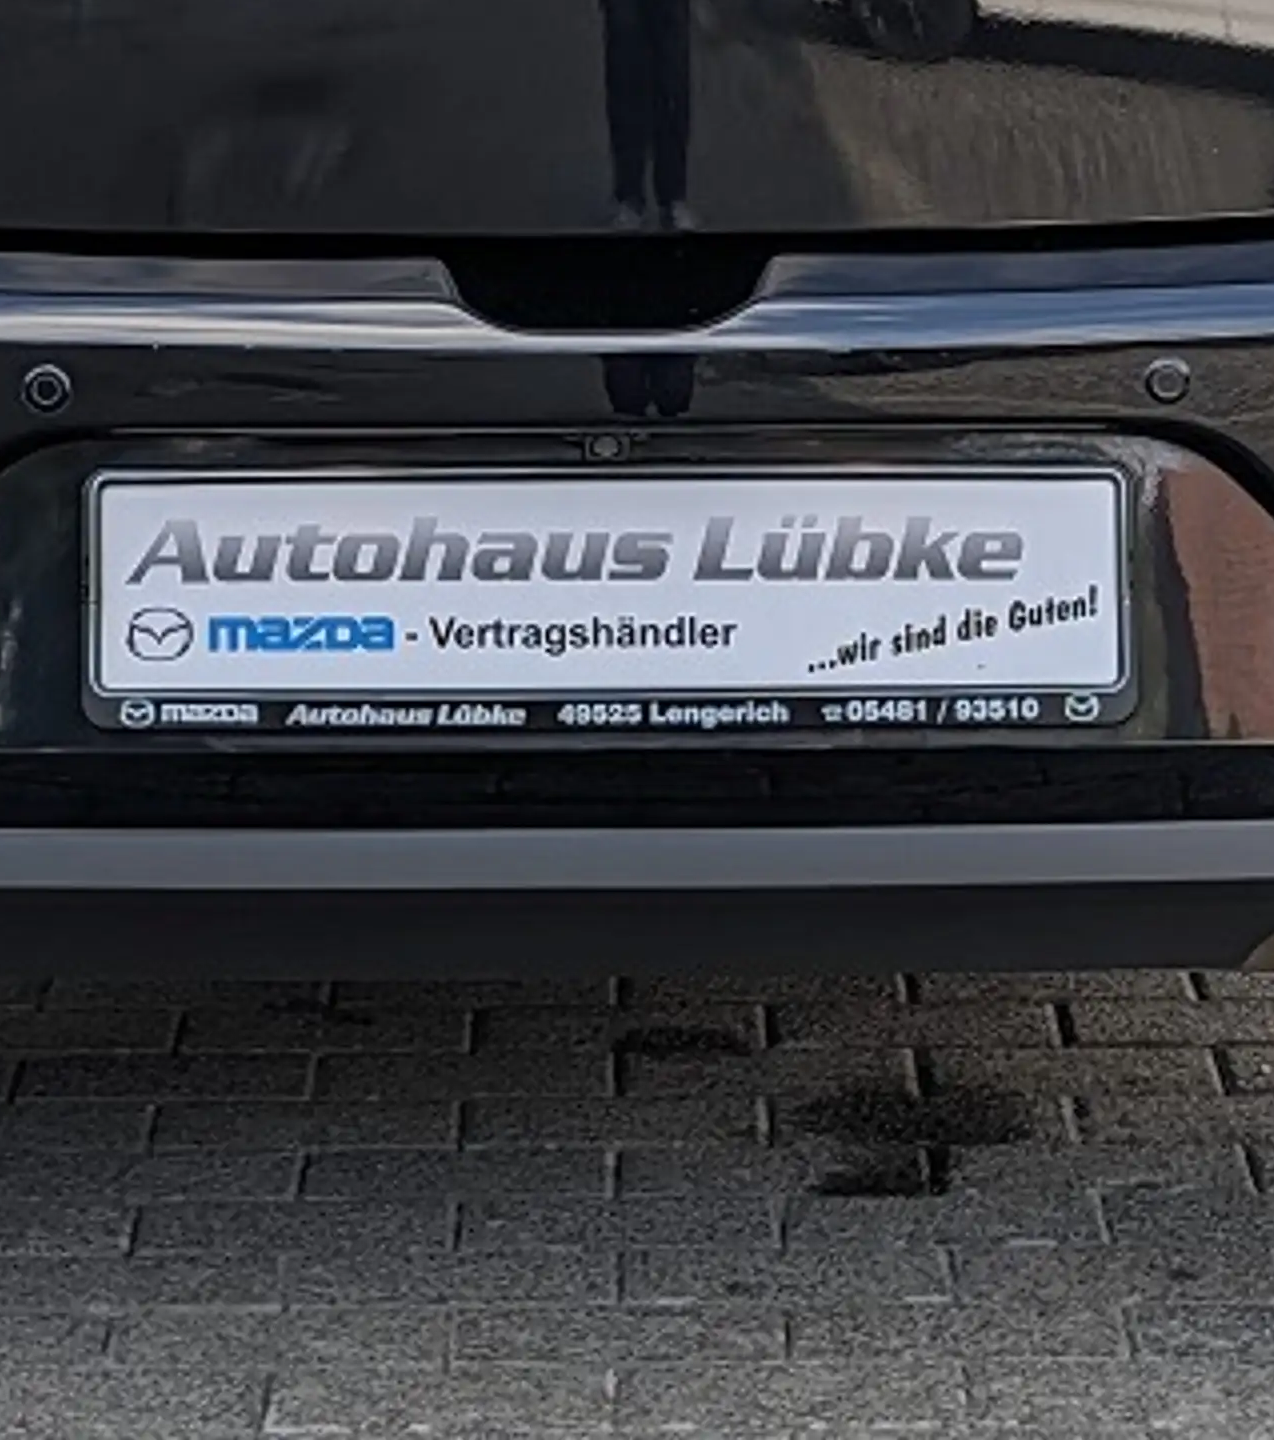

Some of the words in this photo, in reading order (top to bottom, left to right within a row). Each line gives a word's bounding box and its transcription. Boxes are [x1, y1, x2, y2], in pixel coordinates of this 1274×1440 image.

[125, 516, 672, 585] Autohaus
[692, 515, 1024, 581] Lübke
[428, 616, 738, 655] Vertragshändler
[890, 615, 946, 657] sind
[956, 607, 999, 644] die
[1007, 584, 1099, 633] Guten!
[285, 703, 433, 727] Autohaus
[437, 702, 527, 727] Lübke
[556, 702, 643, 726] 49525
[648, 700, 791, 728] Lengerich
[847, 698, 928, 722] 05481
[953, 696, 1040, 721] 93510
